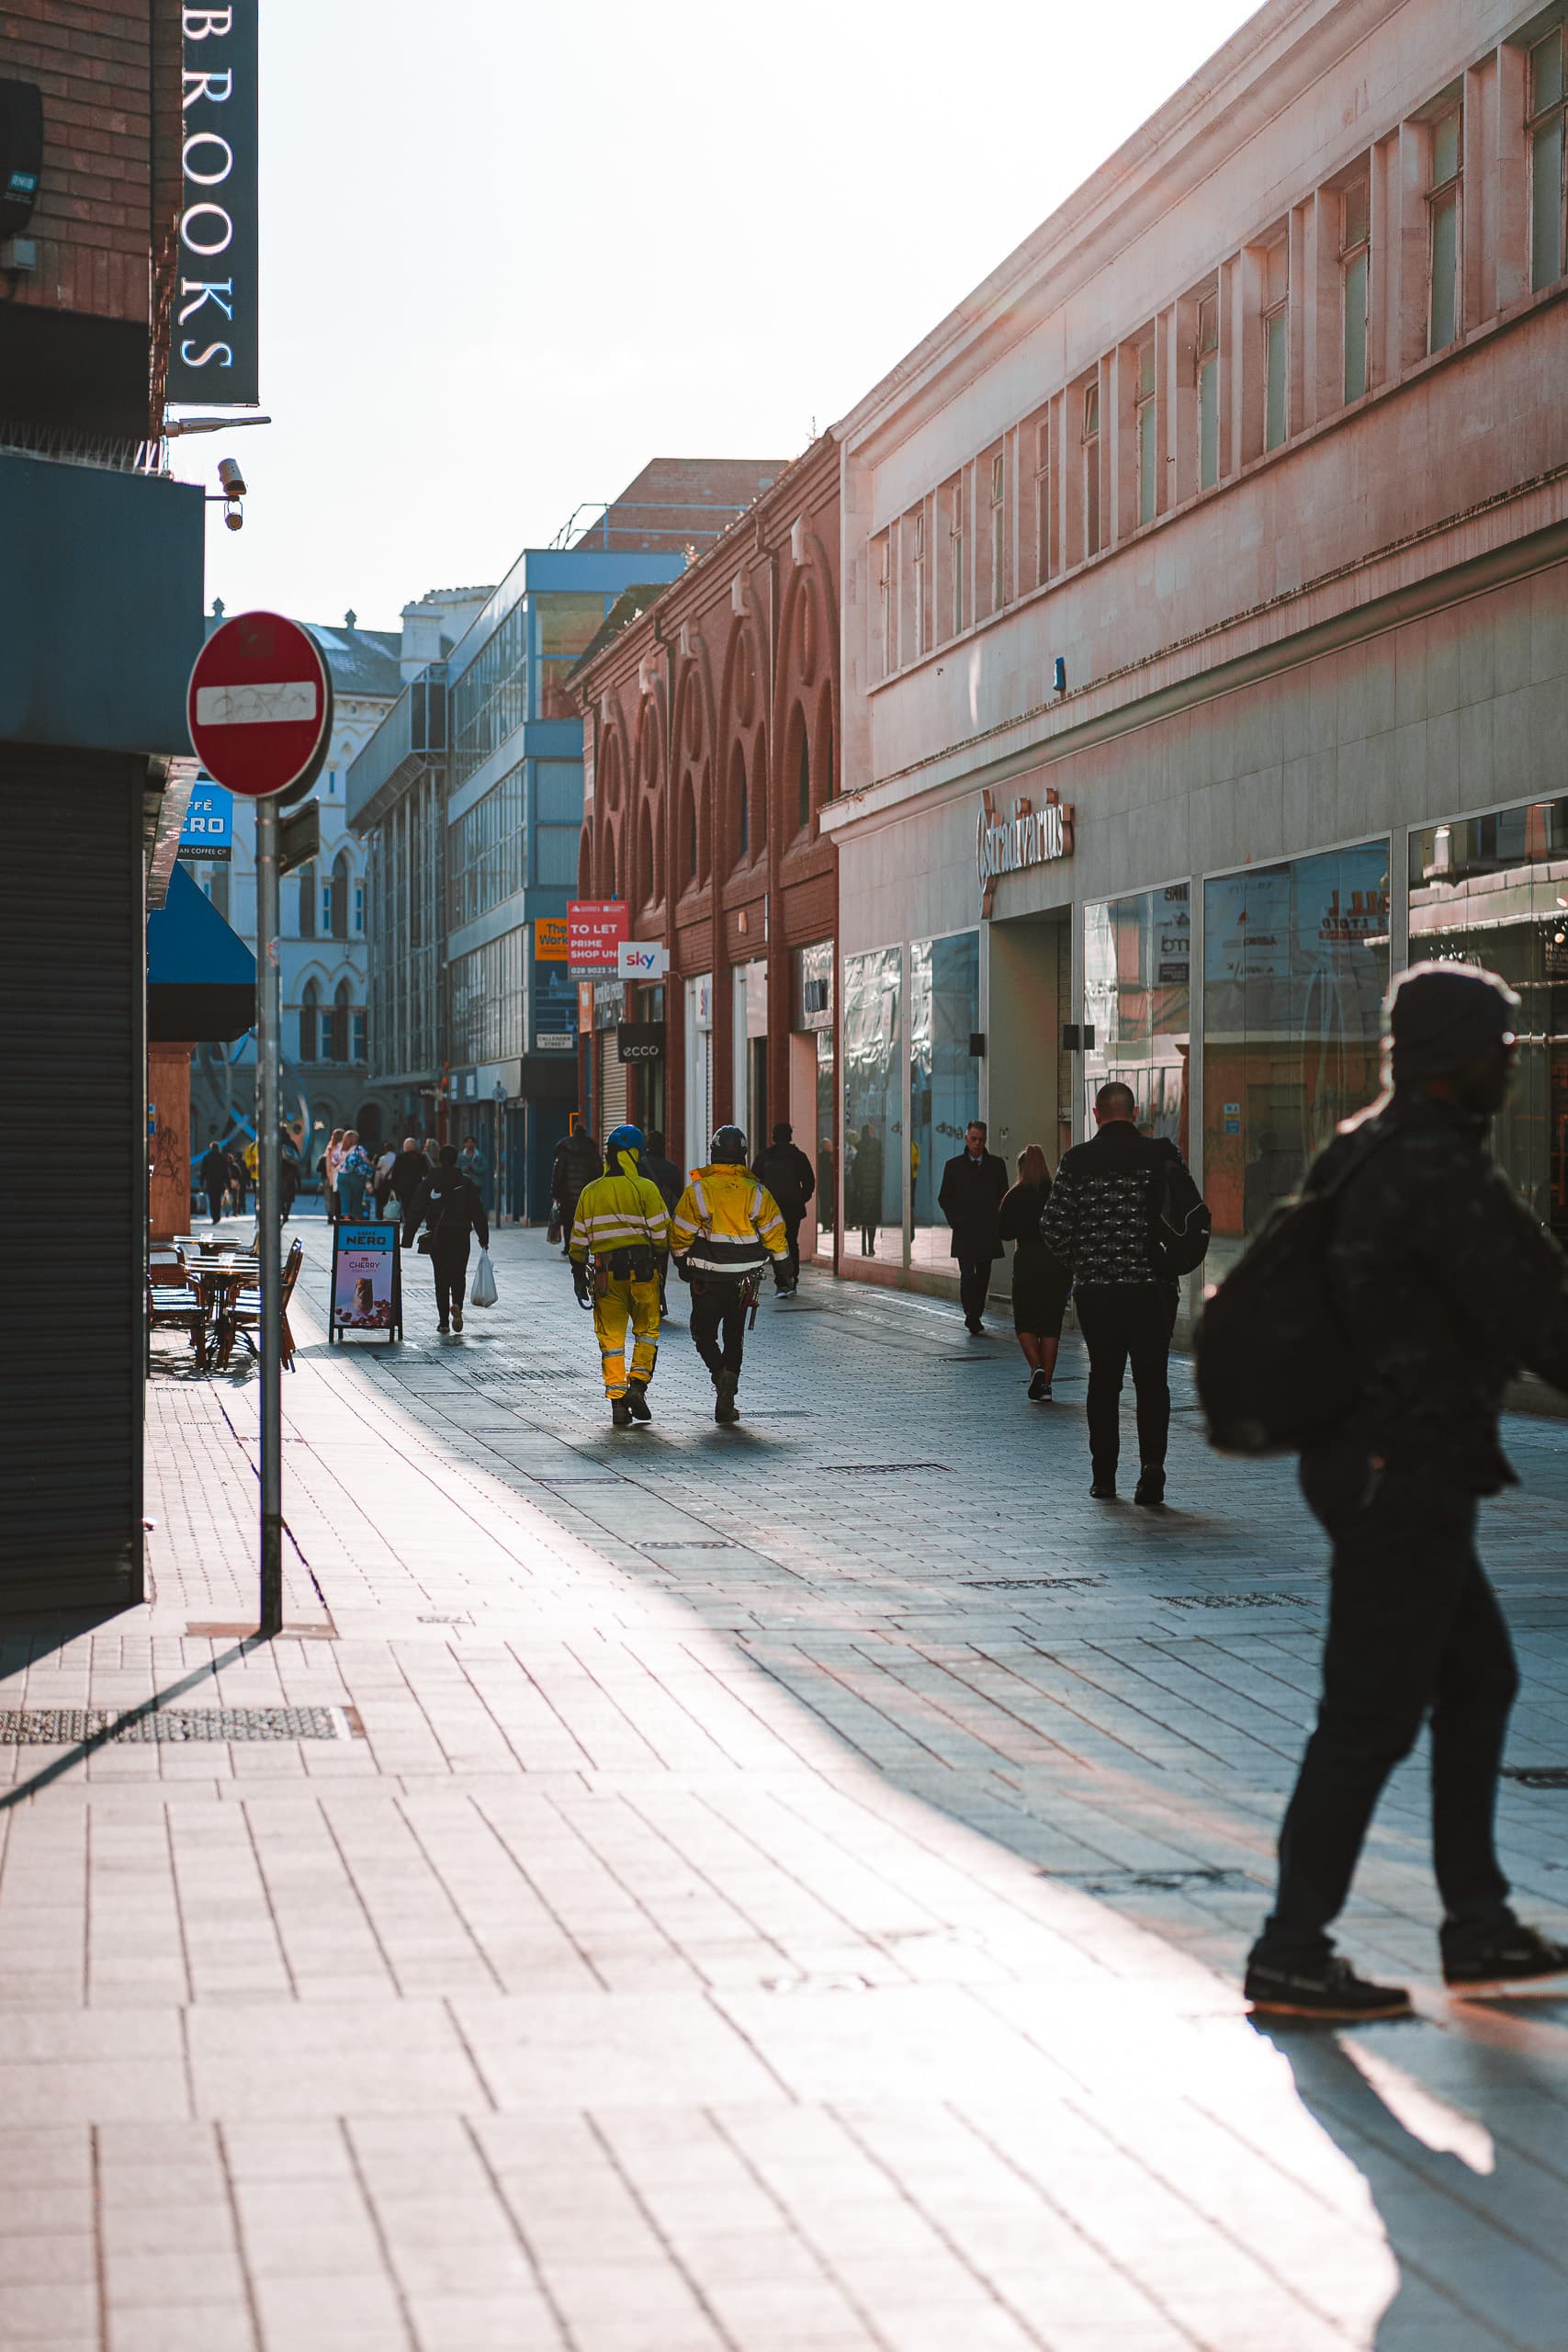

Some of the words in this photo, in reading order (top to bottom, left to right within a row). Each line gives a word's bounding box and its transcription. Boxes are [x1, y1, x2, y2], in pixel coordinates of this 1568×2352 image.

[178, 5, 233, 368] BROOKS
[546, 923, 567, 934] The
[570, 923, 590, 934] TO
[593, 923, 617, 934] LET
[570, 939, 603, 948] PRIME
[570, 950, 600, 959] SHOP
[603, 950, 618, 959] UN
[626, 951, 656, 970] sky
[571, 967, 586, 975] 028
[608, 967, 618, 975] 34
[623, 1045, 659, 1057] ecco
[346, 1236, 387, 1246] NERO
[349, 1261, 380, 1270] CHERRY
